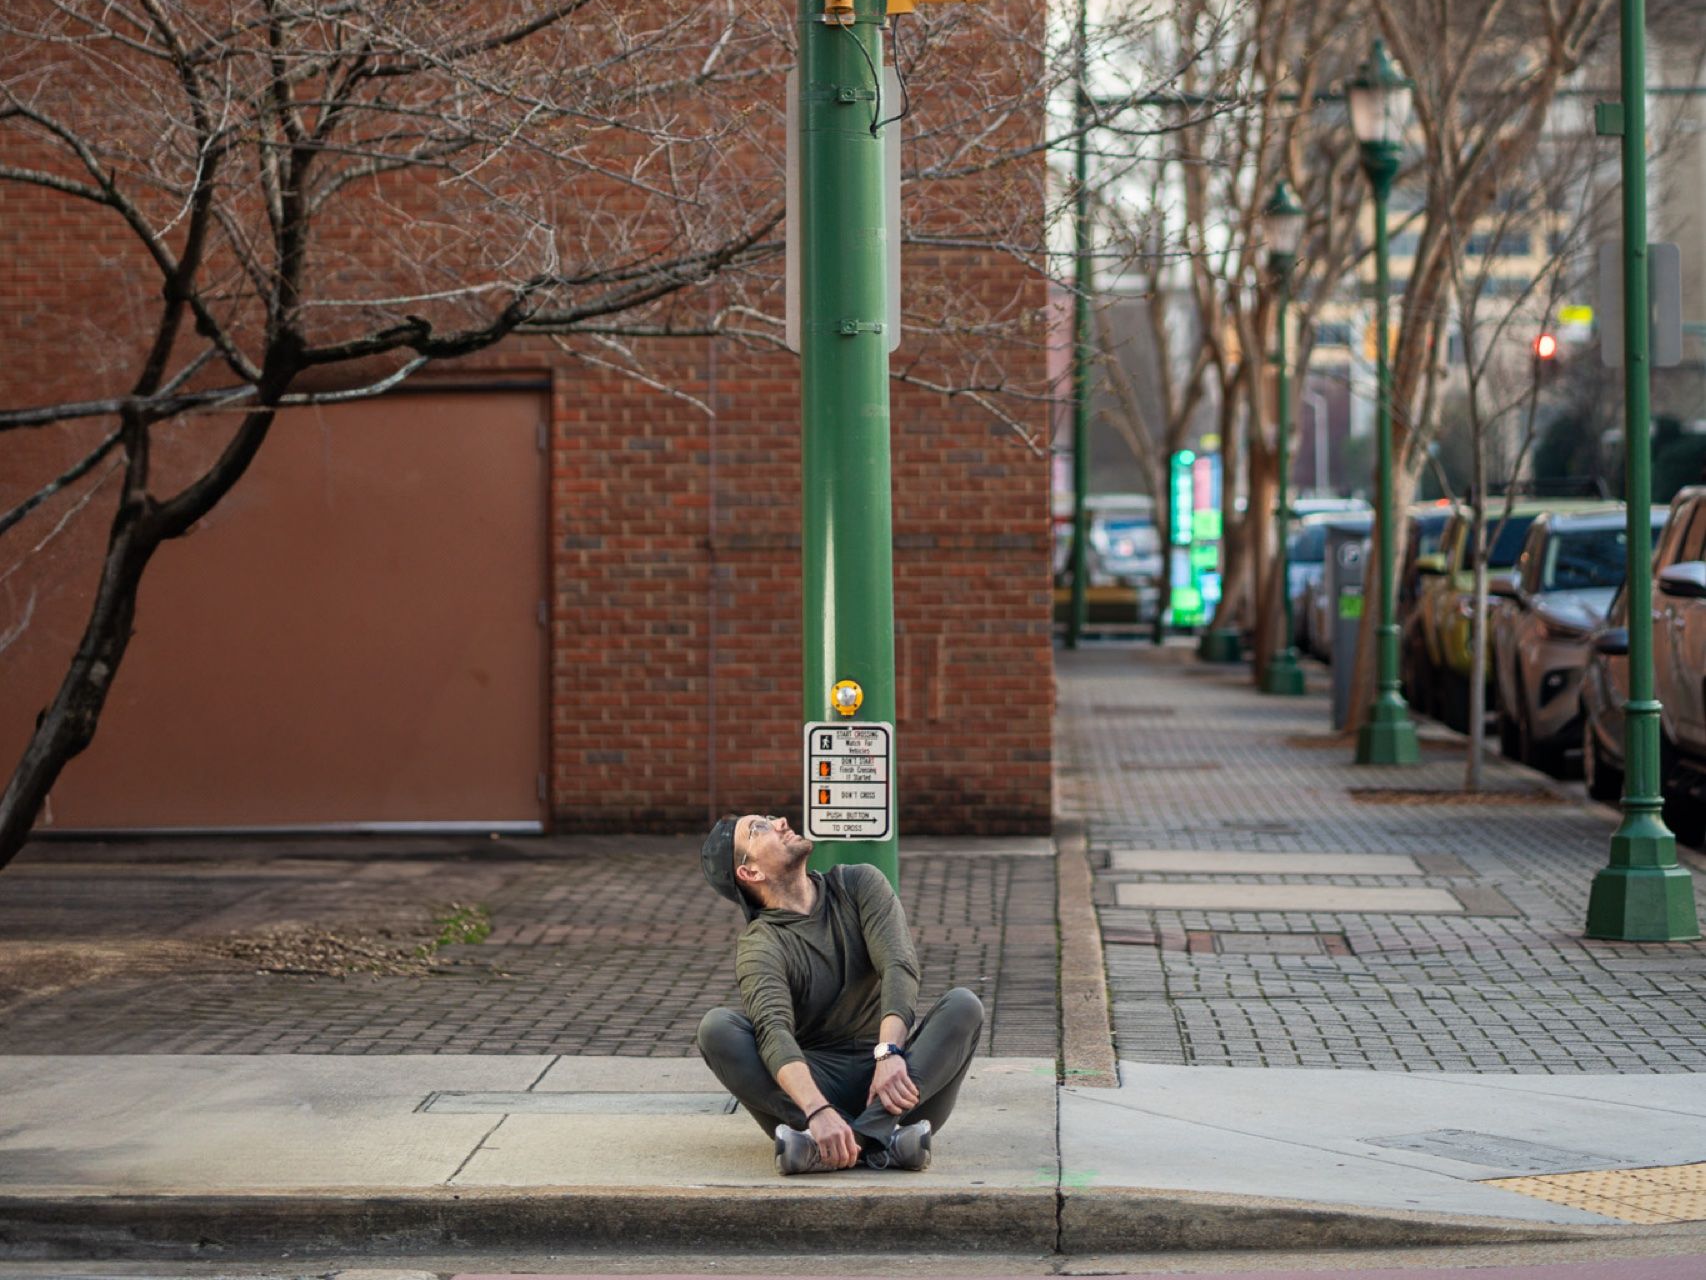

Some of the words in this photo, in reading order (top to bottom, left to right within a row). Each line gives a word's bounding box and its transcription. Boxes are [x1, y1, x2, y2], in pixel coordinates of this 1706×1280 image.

[841, 791, 858, 799] DON'T
[860, 791, 876, 799] CROSS
[846, 811, 870, 819] BUTTON
